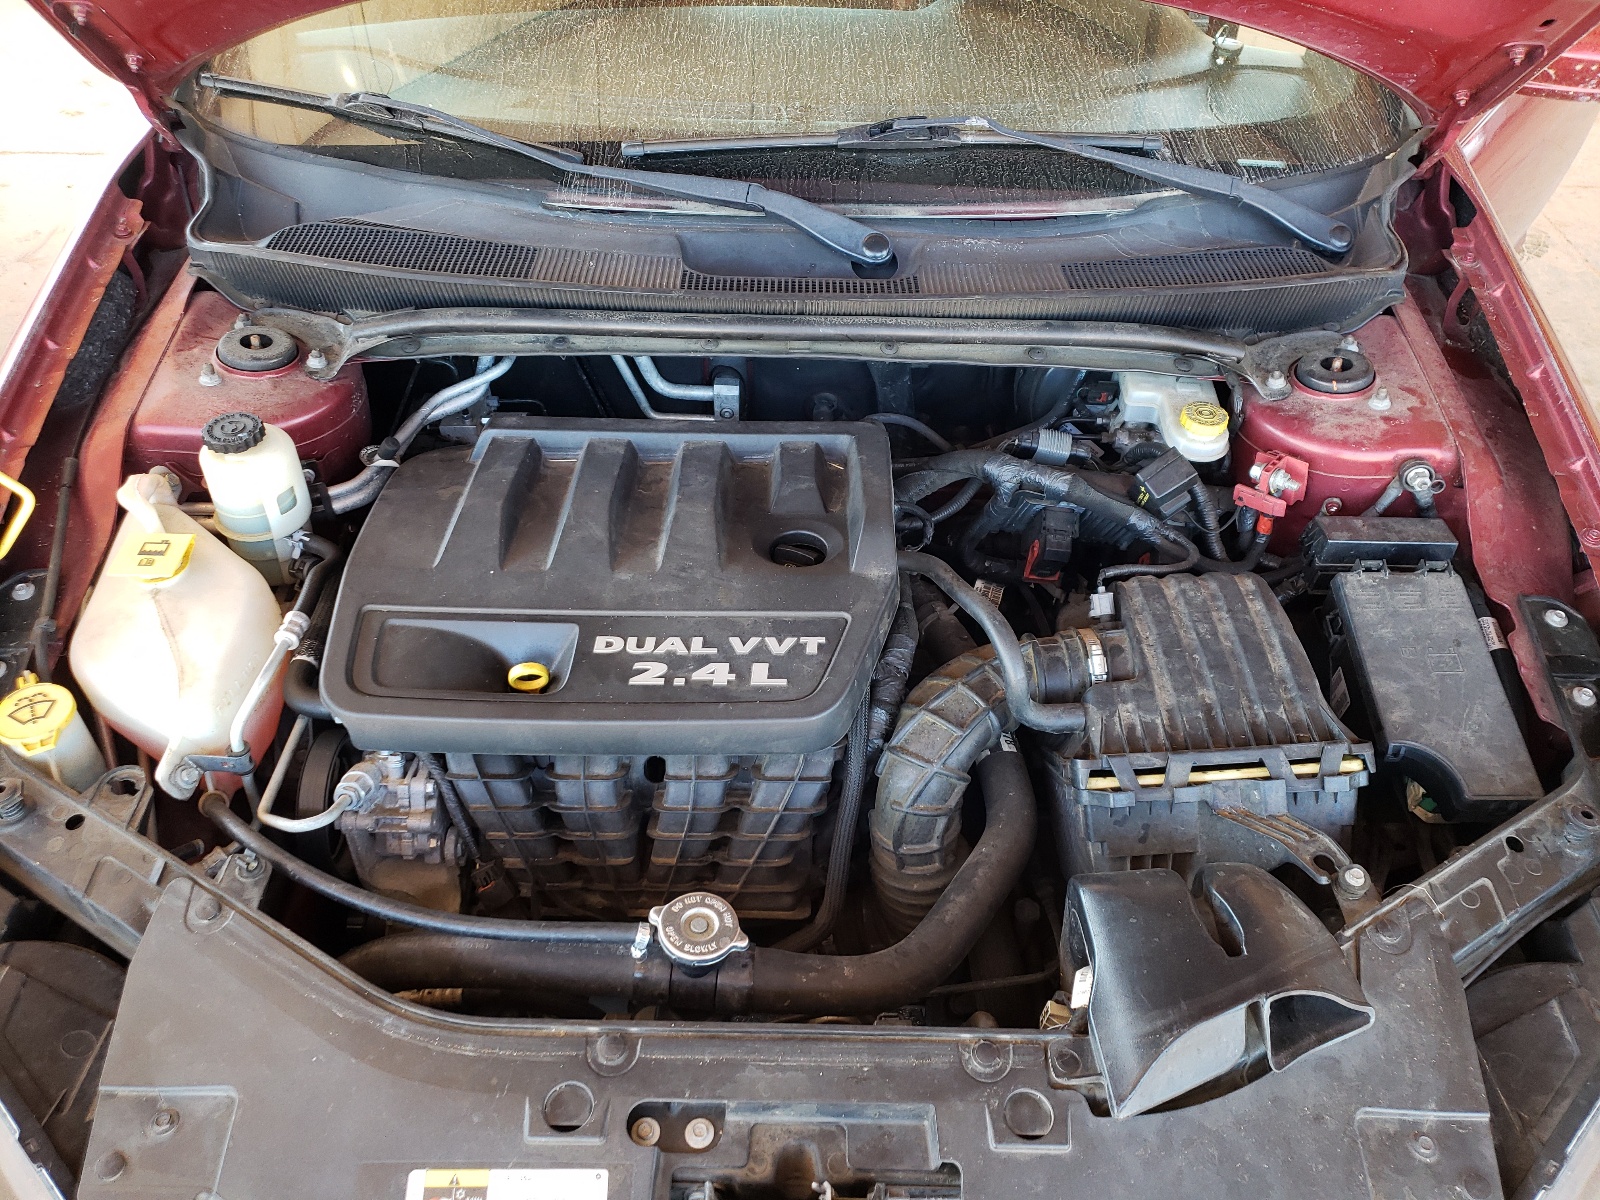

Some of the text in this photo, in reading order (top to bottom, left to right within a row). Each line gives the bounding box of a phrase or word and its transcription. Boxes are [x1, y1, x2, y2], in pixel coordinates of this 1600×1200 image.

[593, 635, 826, 655] DUAL VVT
[628, 661, 788, 686] 2.4 L
[671, 895, 734, 929] DO NOT OPEN HOT
[665, 925, 718, 953] OPEN SLOWLY
